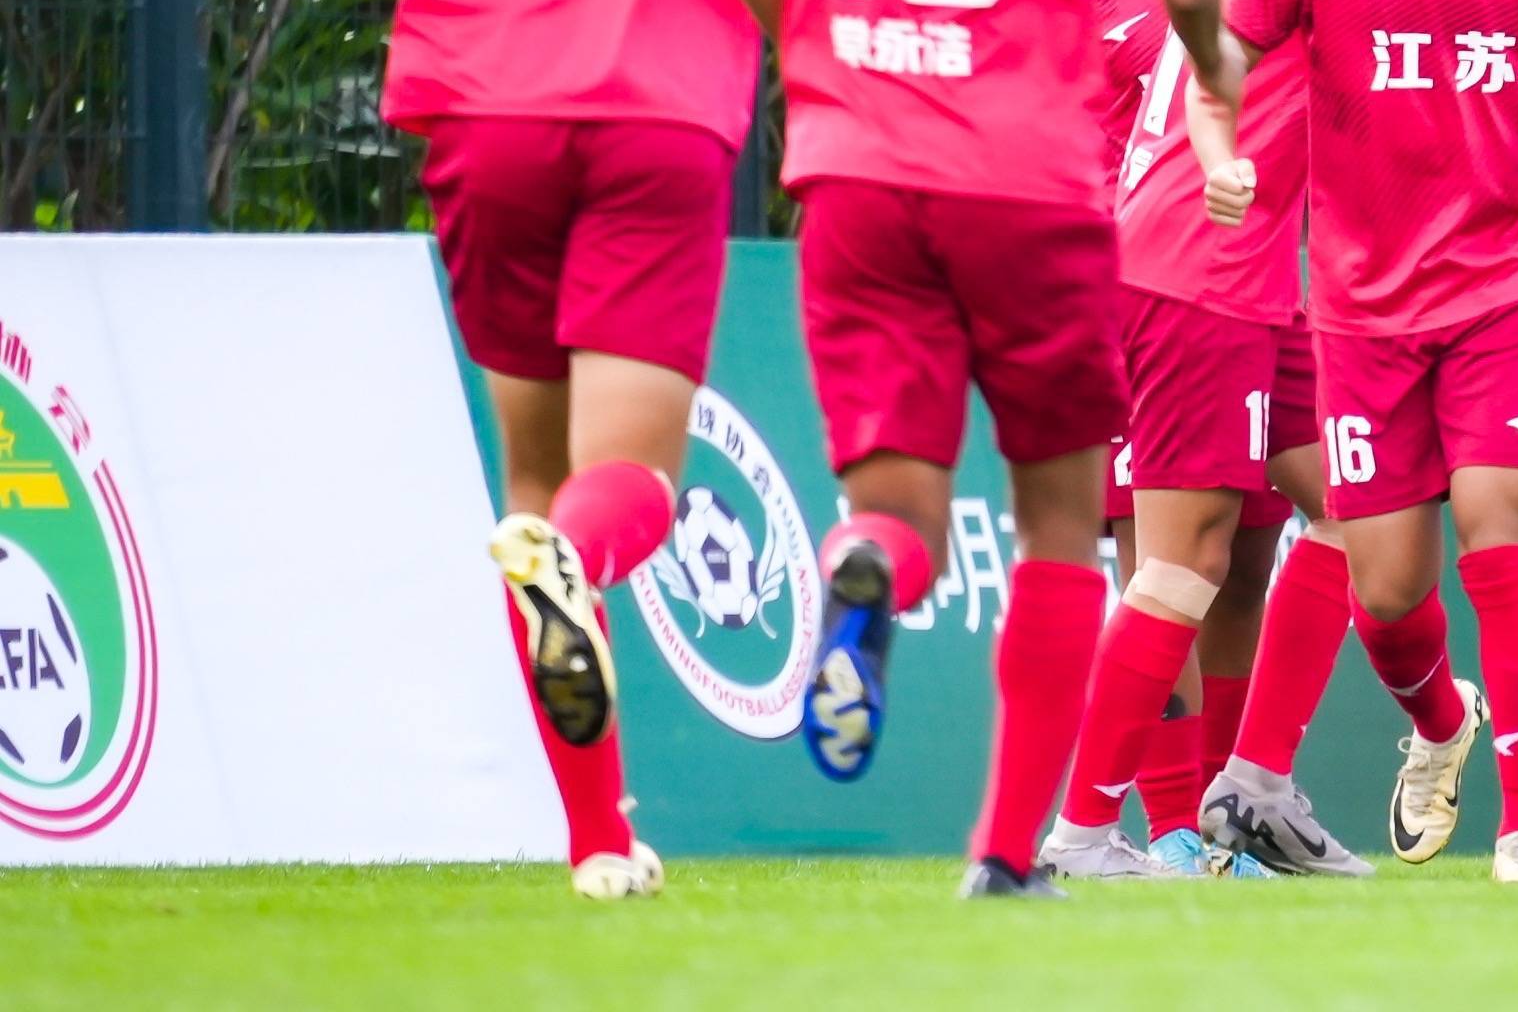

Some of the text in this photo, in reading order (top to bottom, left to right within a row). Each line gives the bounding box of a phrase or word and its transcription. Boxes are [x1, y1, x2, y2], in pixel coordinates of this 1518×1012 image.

[1370, 30, 1517, 94] 江苏
[1324, 415, 1377, 487] 16
[0, 628, 65, 690] FA
